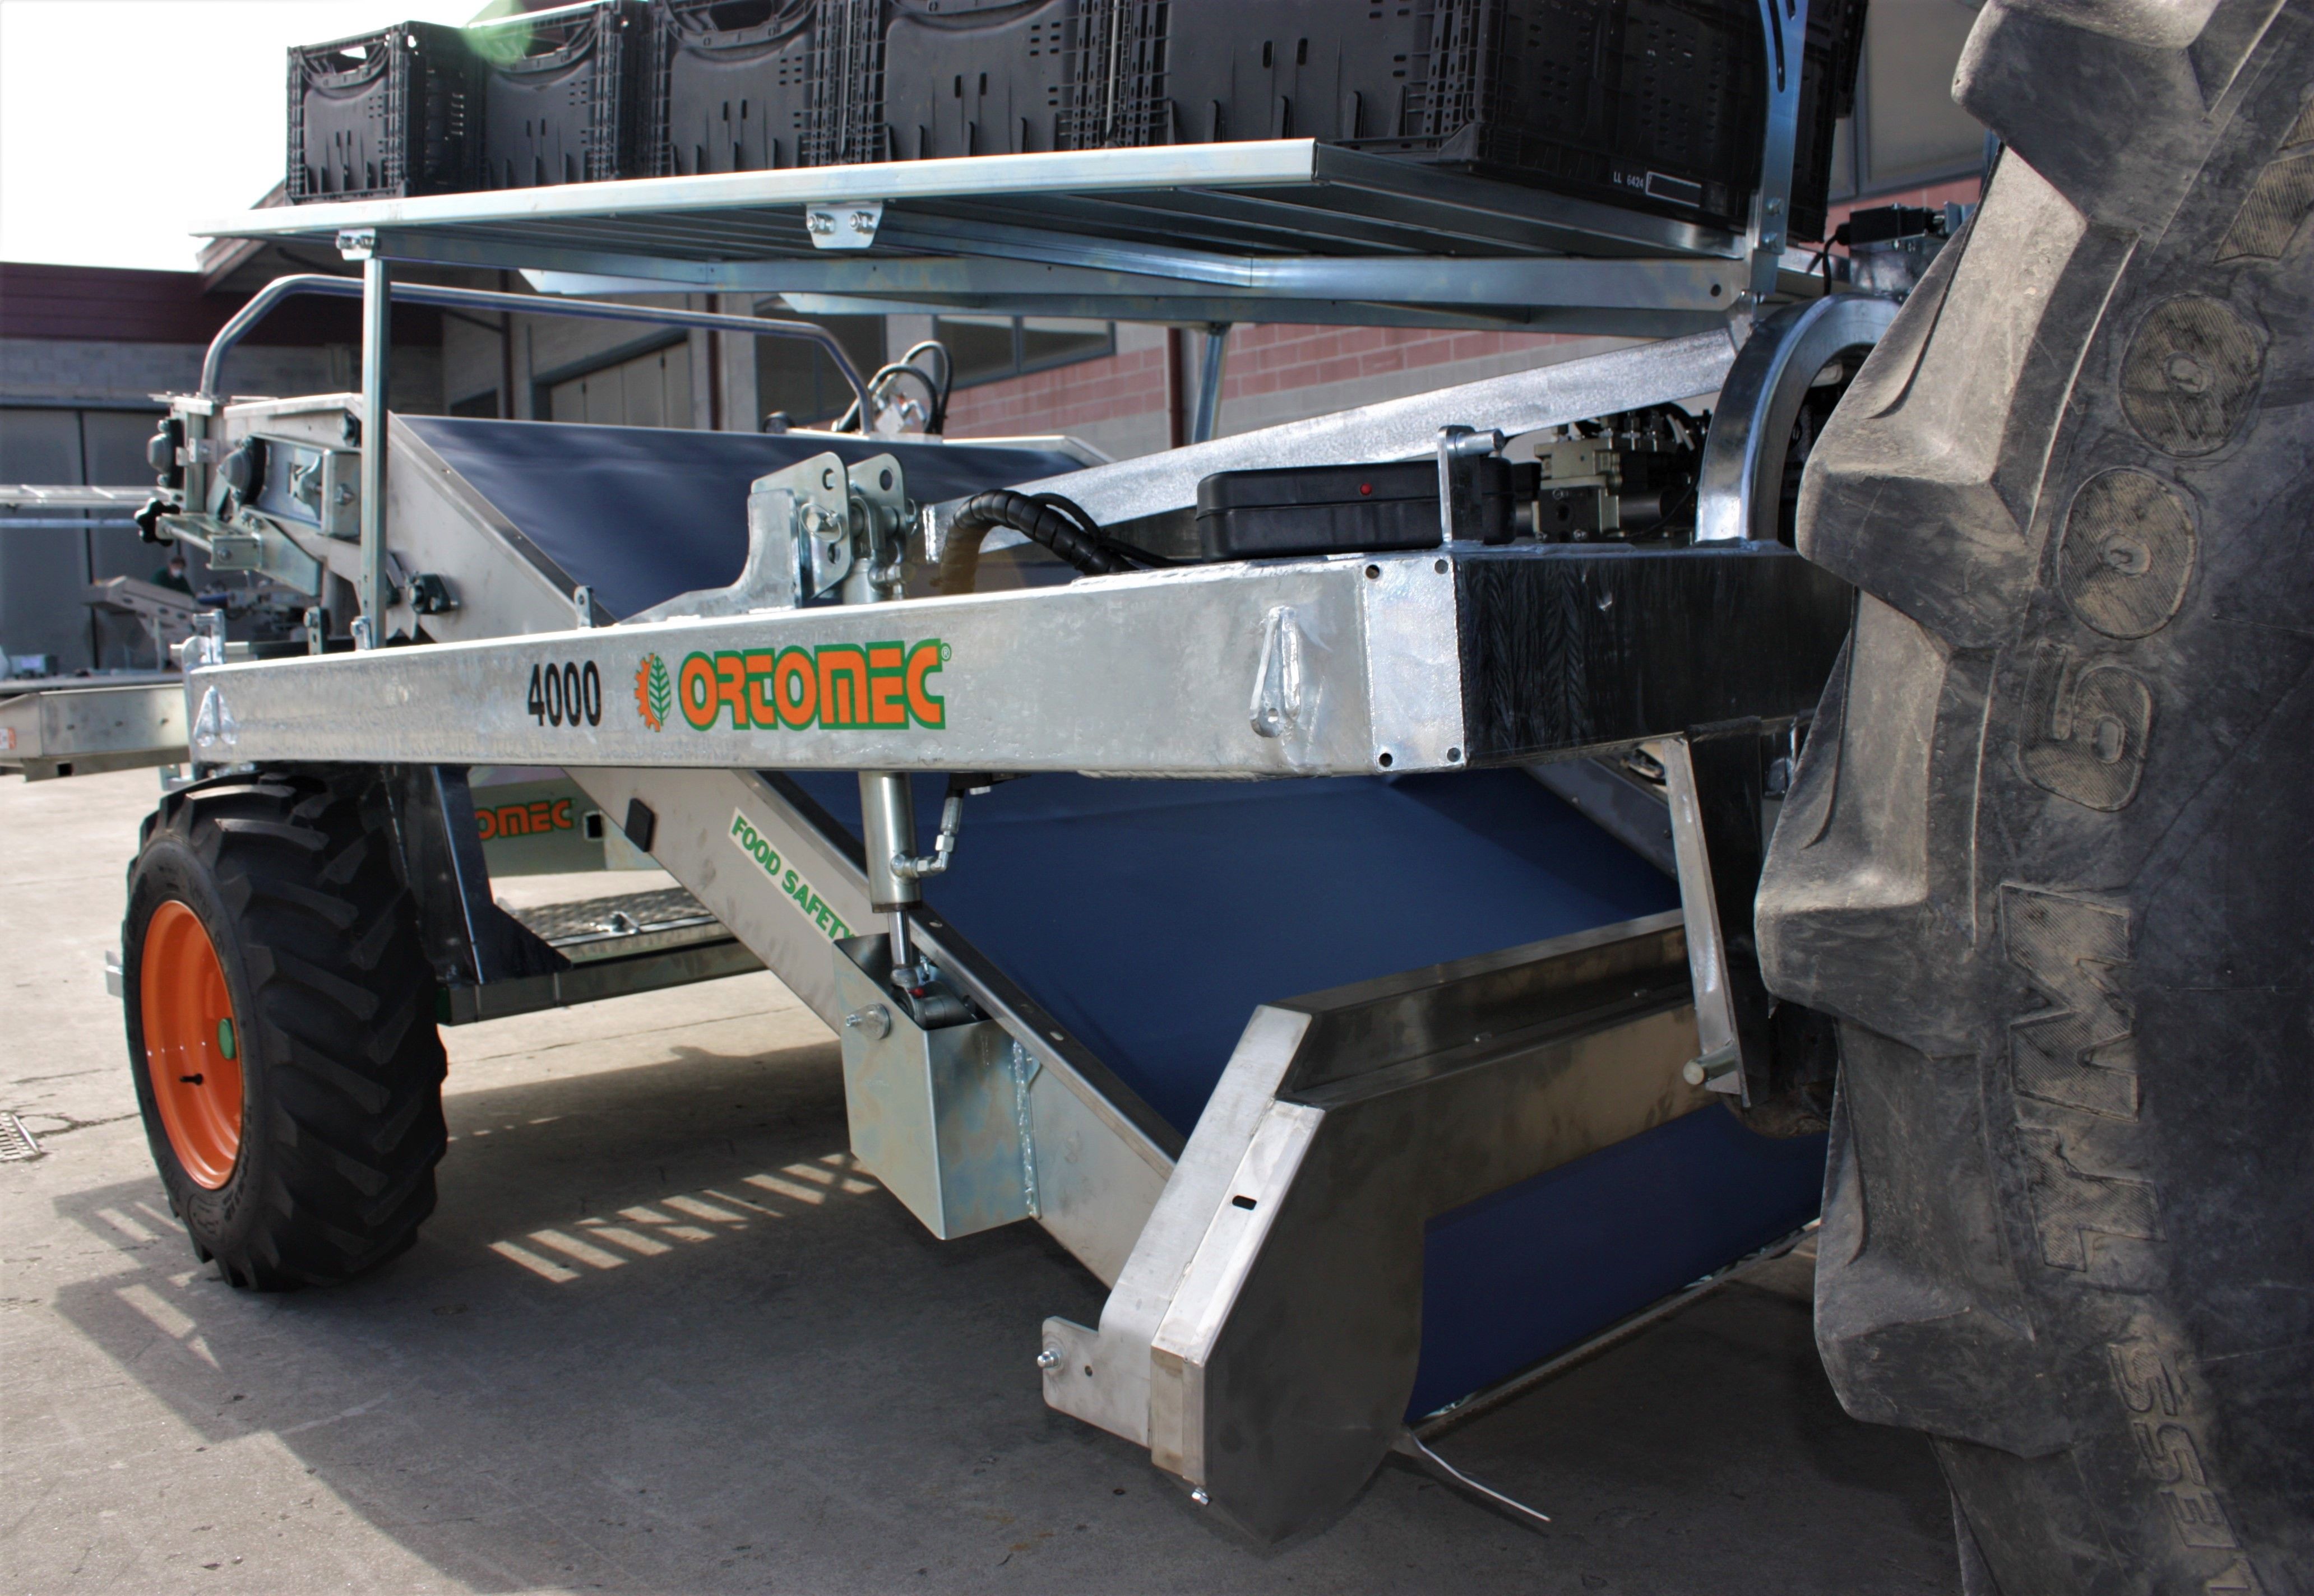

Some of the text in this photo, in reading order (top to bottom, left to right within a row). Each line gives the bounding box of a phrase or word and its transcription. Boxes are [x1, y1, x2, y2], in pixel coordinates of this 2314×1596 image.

[1627, 174, 1644, 189] 6424
[528, 660, 601, 727] 4000
[678, 638, 946, 732] ORTOMEC
[731, 815, 781, 875] FOOD
